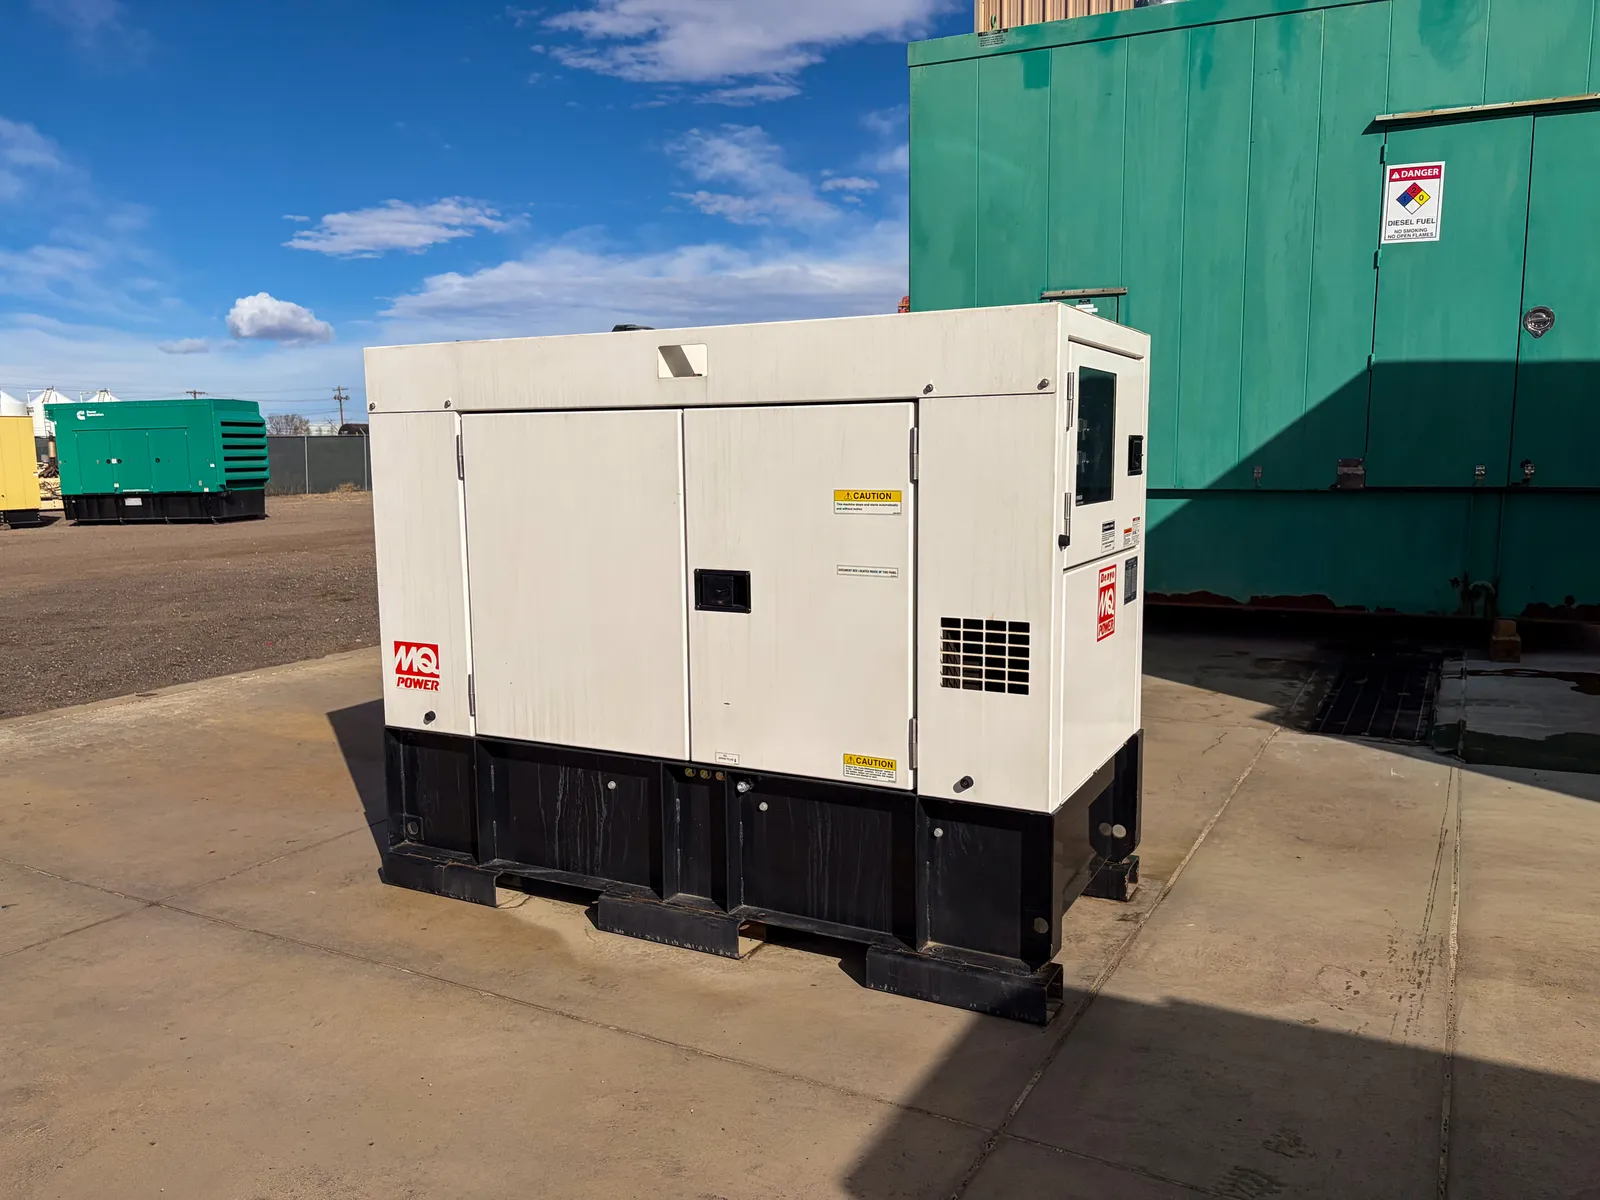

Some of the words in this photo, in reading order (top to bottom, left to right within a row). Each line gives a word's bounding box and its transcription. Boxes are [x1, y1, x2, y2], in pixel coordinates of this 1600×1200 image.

[1401, 168, 1439, 178] DANGER
[853, 492, 892, 500] CAUTION
[1098, 588, 1115, 617] MQ
[1098, 618, 1114, 637] POWER
[394, 645, 440, 676] MQ
[397, 677, 439, 691] POWER
[856, 757, 893, 768] CAUTION
